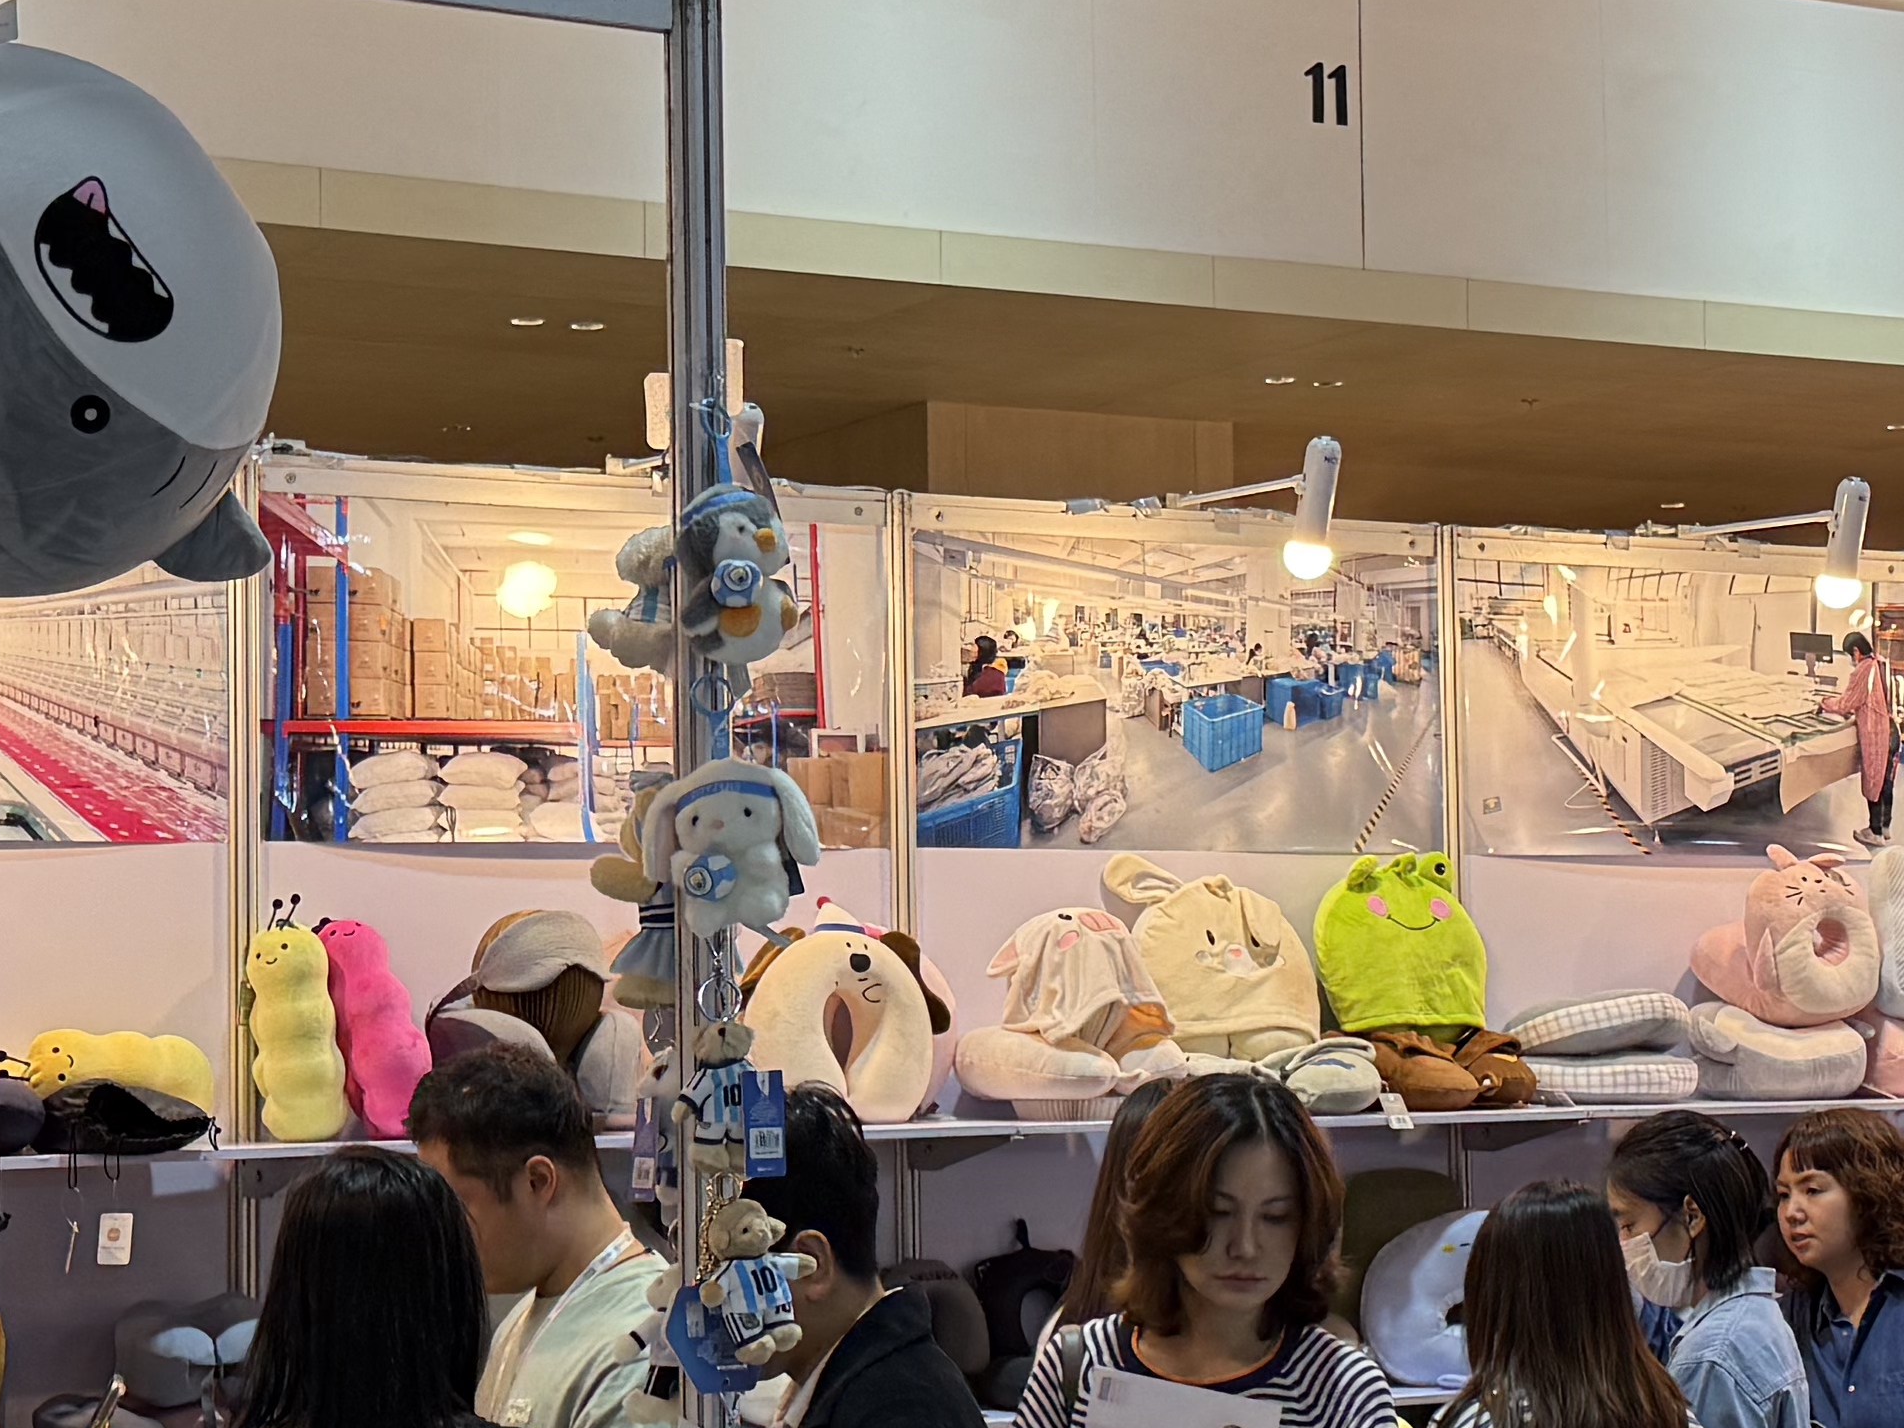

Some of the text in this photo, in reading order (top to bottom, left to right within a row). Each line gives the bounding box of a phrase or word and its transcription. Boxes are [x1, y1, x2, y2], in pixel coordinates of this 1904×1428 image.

[1304, 62, 1348, 126] 11
[723, 1084, 742, 1107] 10
[751, 1266, 778, 1296] 10
